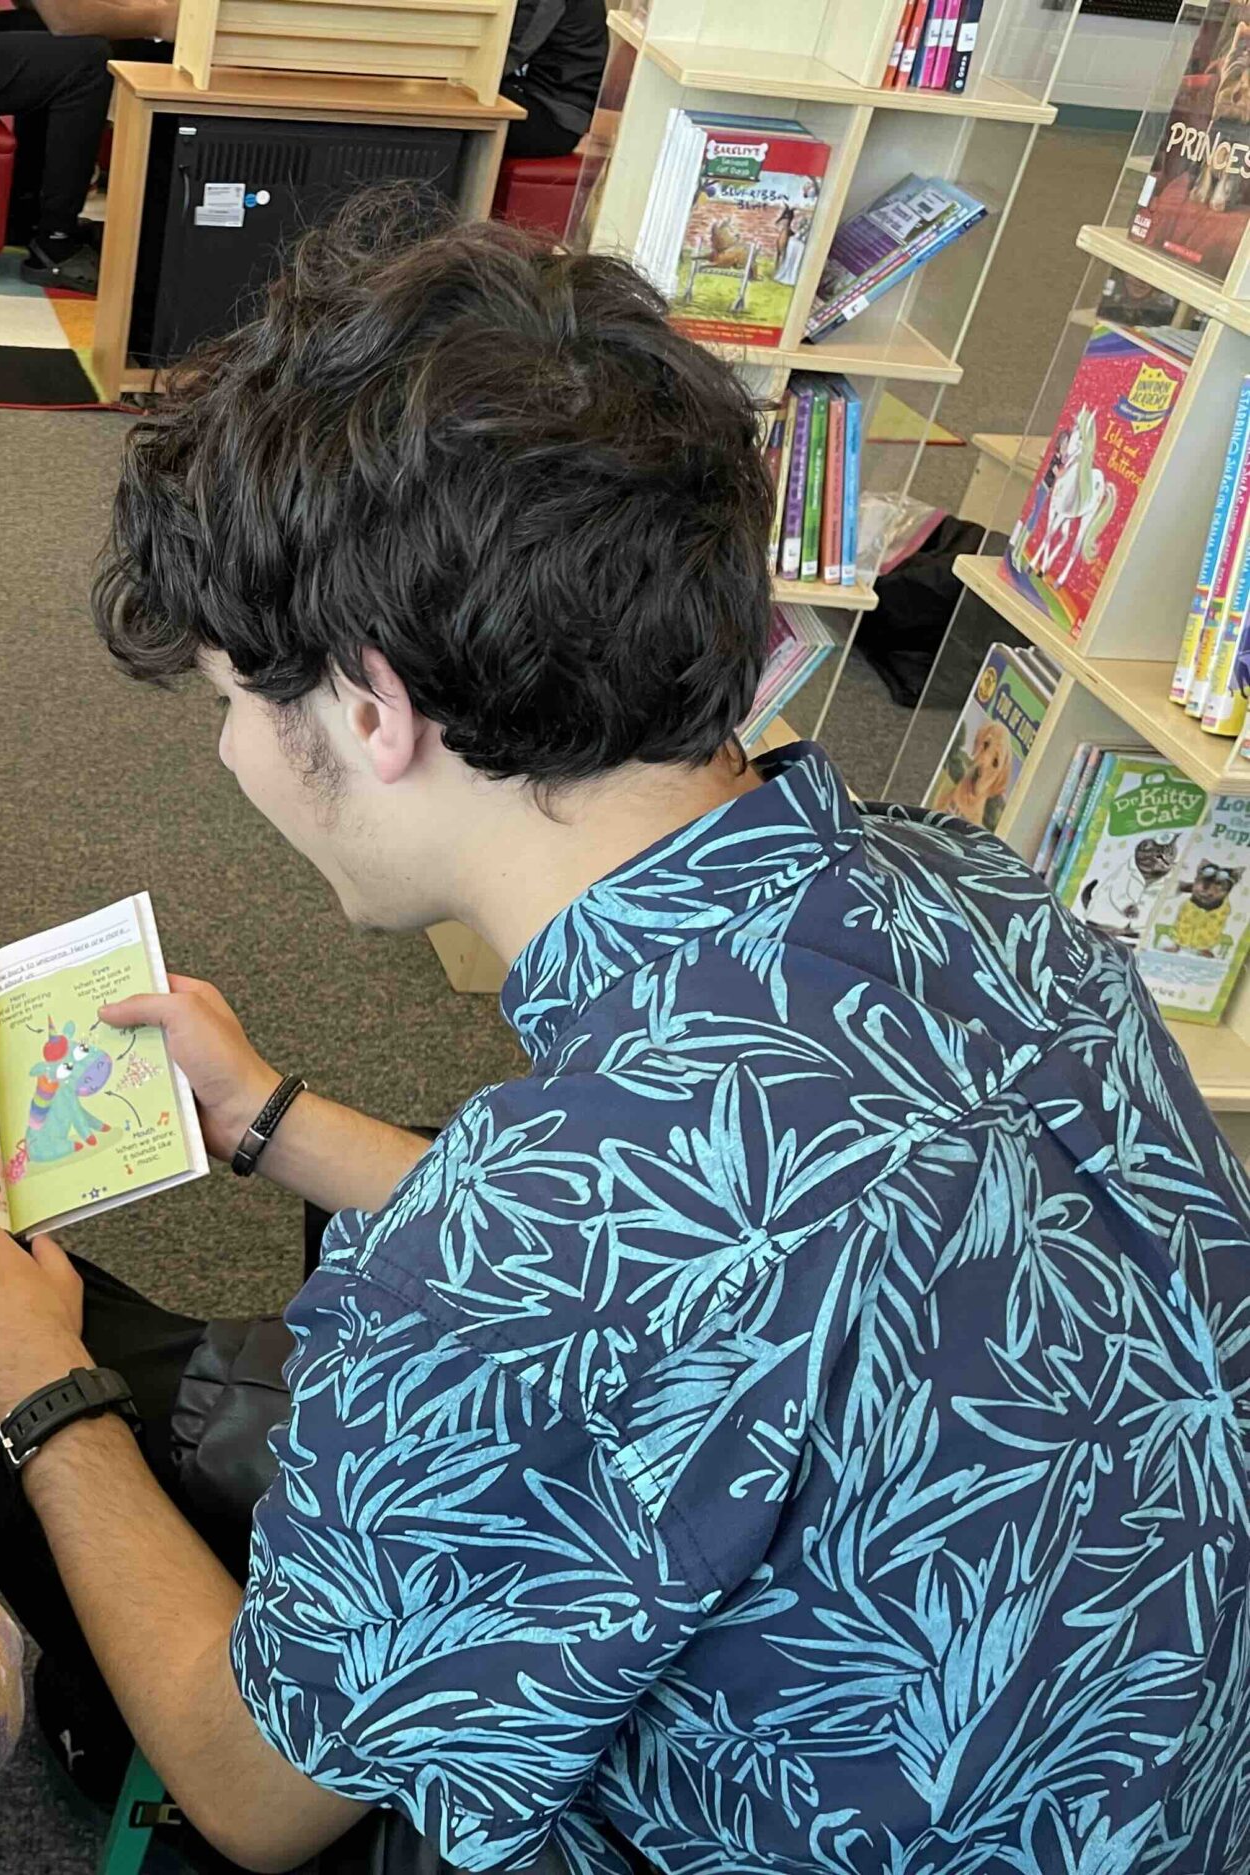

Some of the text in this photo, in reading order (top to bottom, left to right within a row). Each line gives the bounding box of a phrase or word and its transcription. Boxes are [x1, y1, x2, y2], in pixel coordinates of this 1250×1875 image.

[1102, 419, 1124, 449] Isla
[1115, 786, 1203, 812] Dr Kitty
[1136, 806, 1182, 826] Cat
[115, 1143, 138, 1154] When
[130, 1146, 156, 1158] sounds
